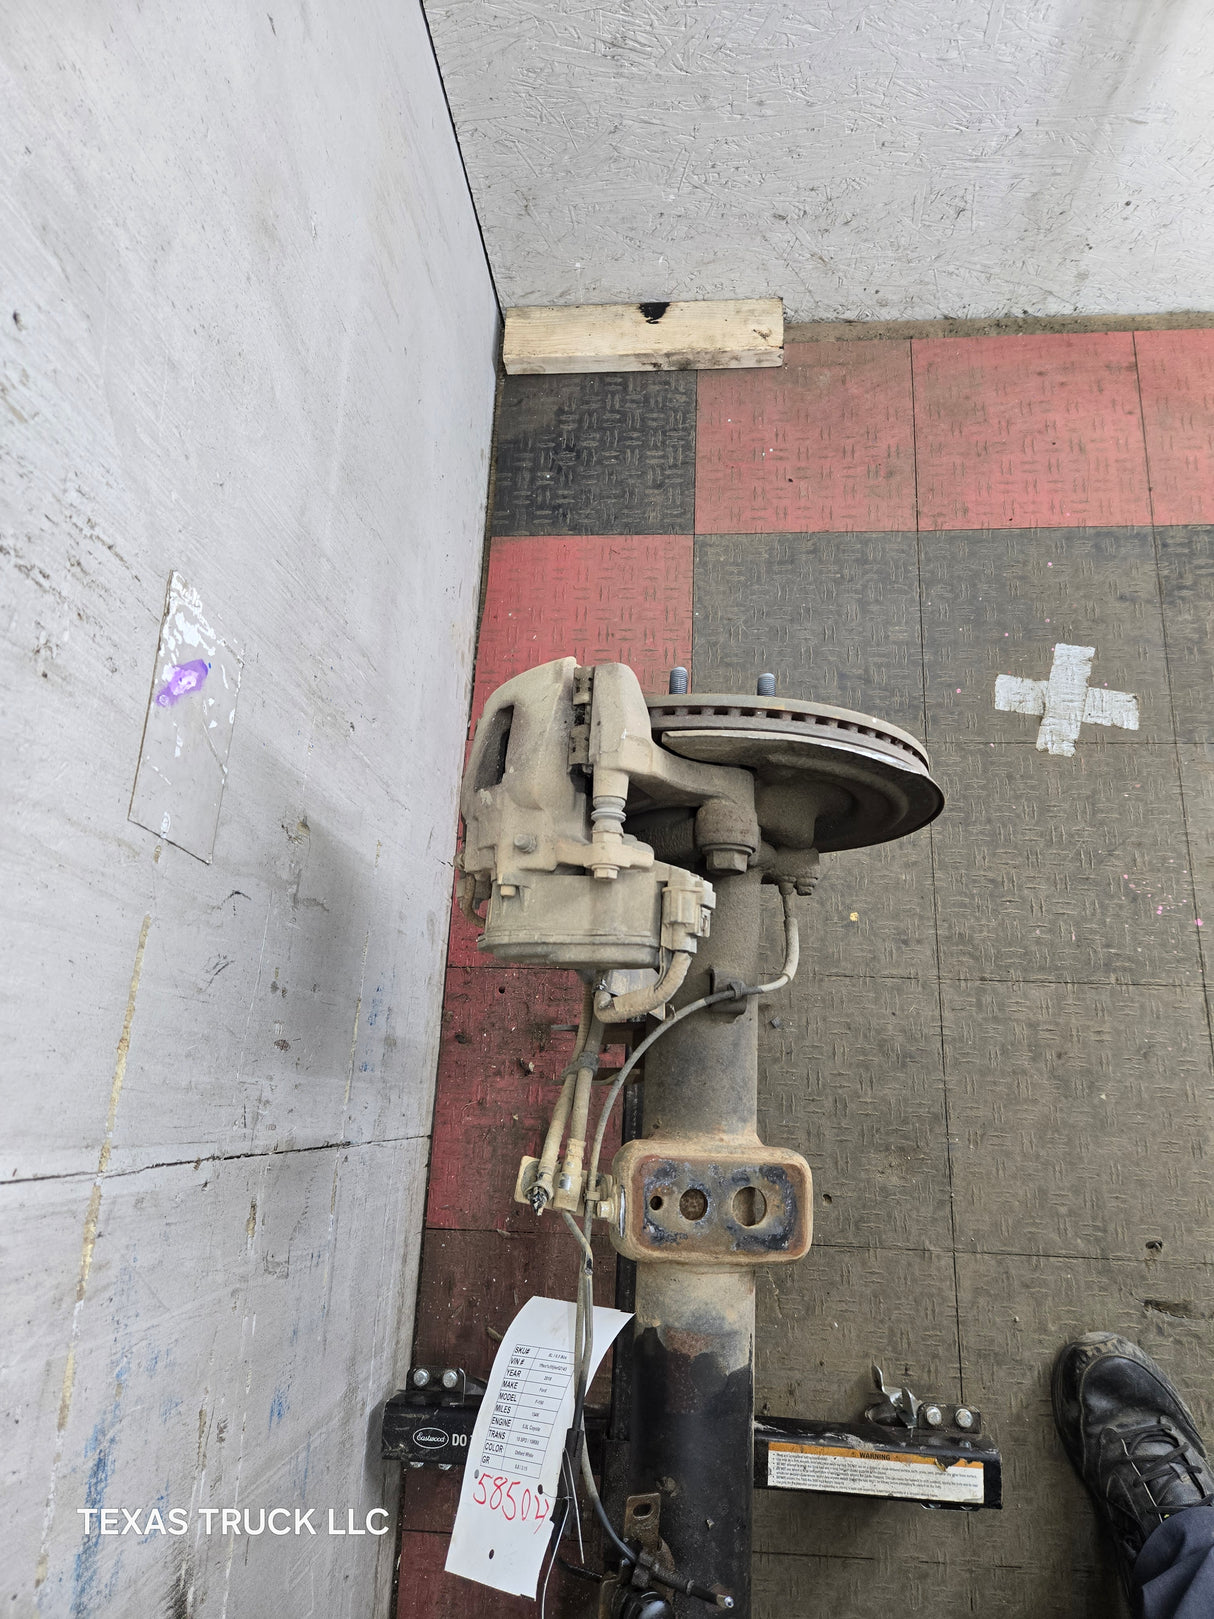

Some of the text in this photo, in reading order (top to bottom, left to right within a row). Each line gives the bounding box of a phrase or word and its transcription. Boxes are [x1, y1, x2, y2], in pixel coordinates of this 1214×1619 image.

[514, 1346, 531, 1355] SKU#
[510, 1357, 519, 1365] VIN
[506, 1368, 522, 1377] YEAR
[502, 1380, 518, 1389] MAKE
[499, 1392, 517, 1402] MODEL
[495, 1404, 511, 1414] MILES
[491, 1417, 512, 1427] ENGINE
[416, 1431, 468, 1447] Eastwood DO
[488, 1429, 506, 1440] TRANS
[484, 1442, 504, 1453] COLOR
[481, 1455, 491, 1464] GR
[859, 1452, 891, 1461] WARNING
[472, 1473, 550, 1534] 58504
